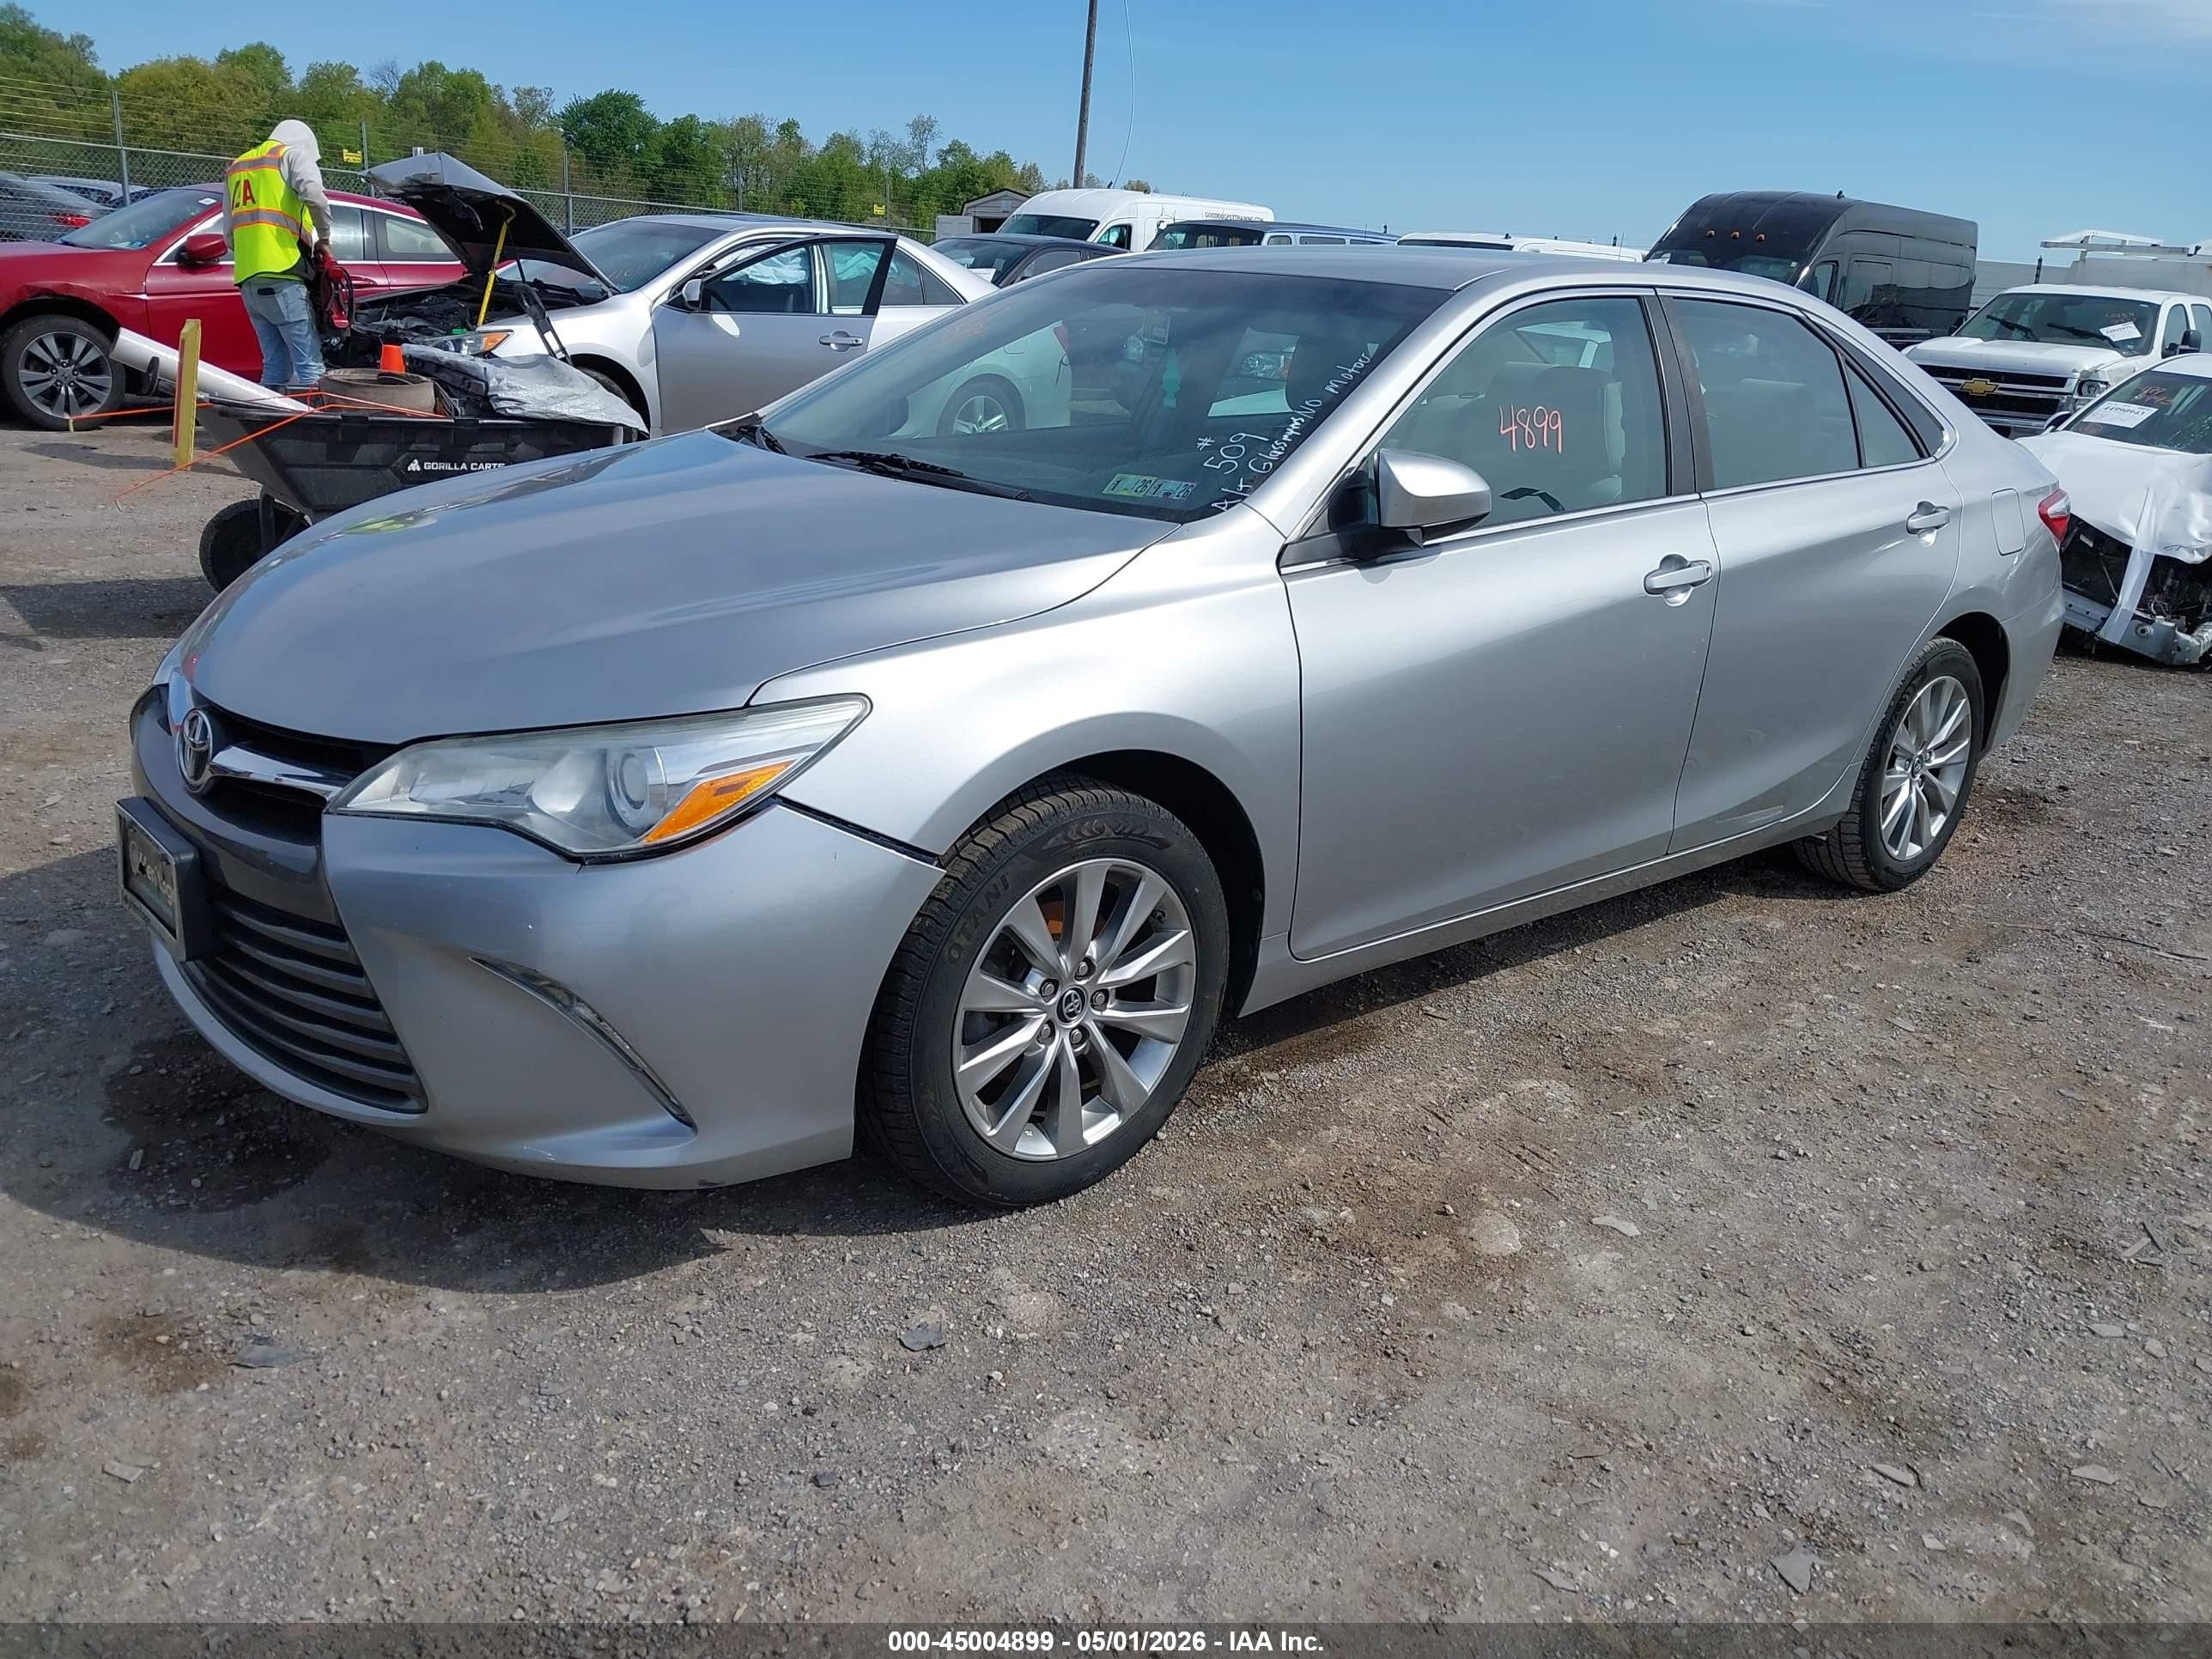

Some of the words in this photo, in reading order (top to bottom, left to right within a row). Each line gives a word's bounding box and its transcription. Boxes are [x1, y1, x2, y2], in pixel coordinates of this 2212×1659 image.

[1498, 404, 1562, 454] 4899
[423, 462, 468, 471] GORILLA
[1203, 432, 1270, 475] 509
[1133, 478, 1152, 494] 26
[1175, 483, 1194, 498] 26
[947, 872, 1010, 963] OTANI
